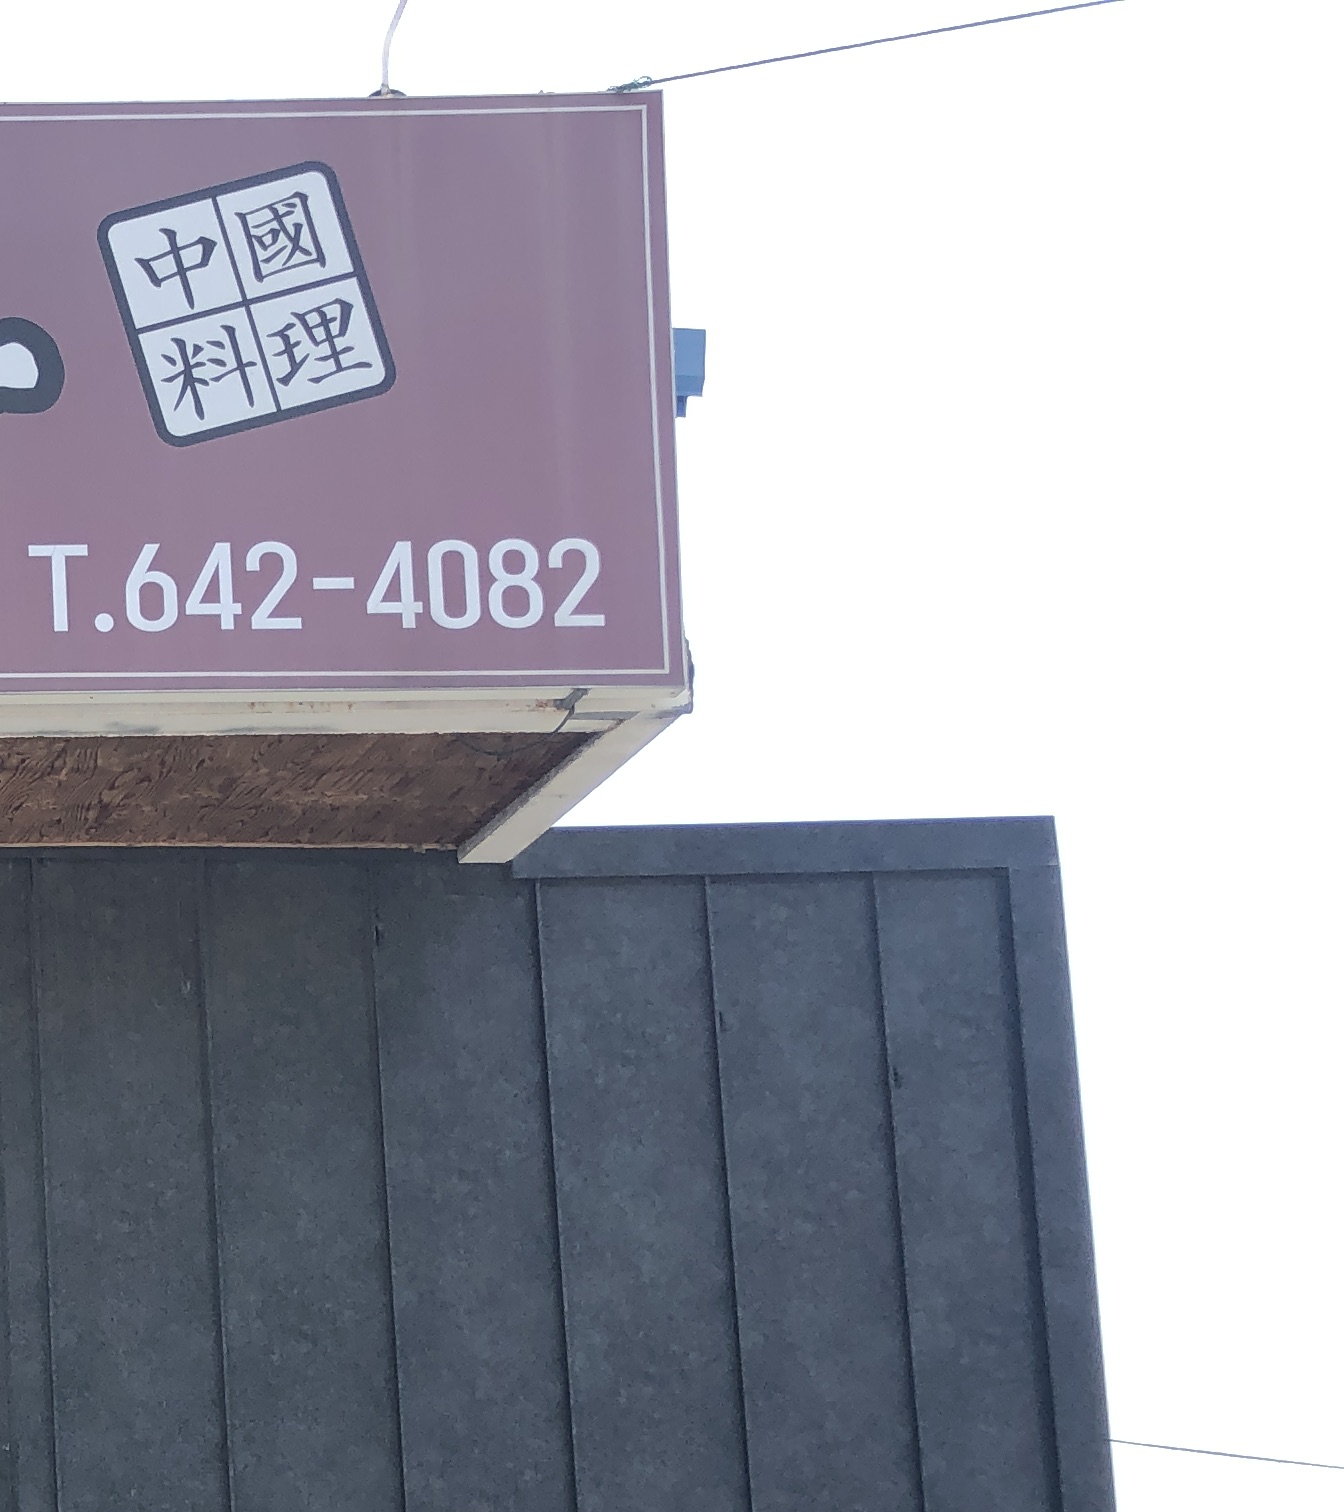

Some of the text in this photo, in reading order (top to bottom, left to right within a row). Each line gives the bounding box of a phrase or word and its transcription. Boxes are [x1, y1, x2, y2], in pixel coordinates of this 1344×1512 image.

[134, 191, 326, 310] 中國
[160, 297, 373, 421] 料理
[28, 537, 608, 634] T.642-4082
